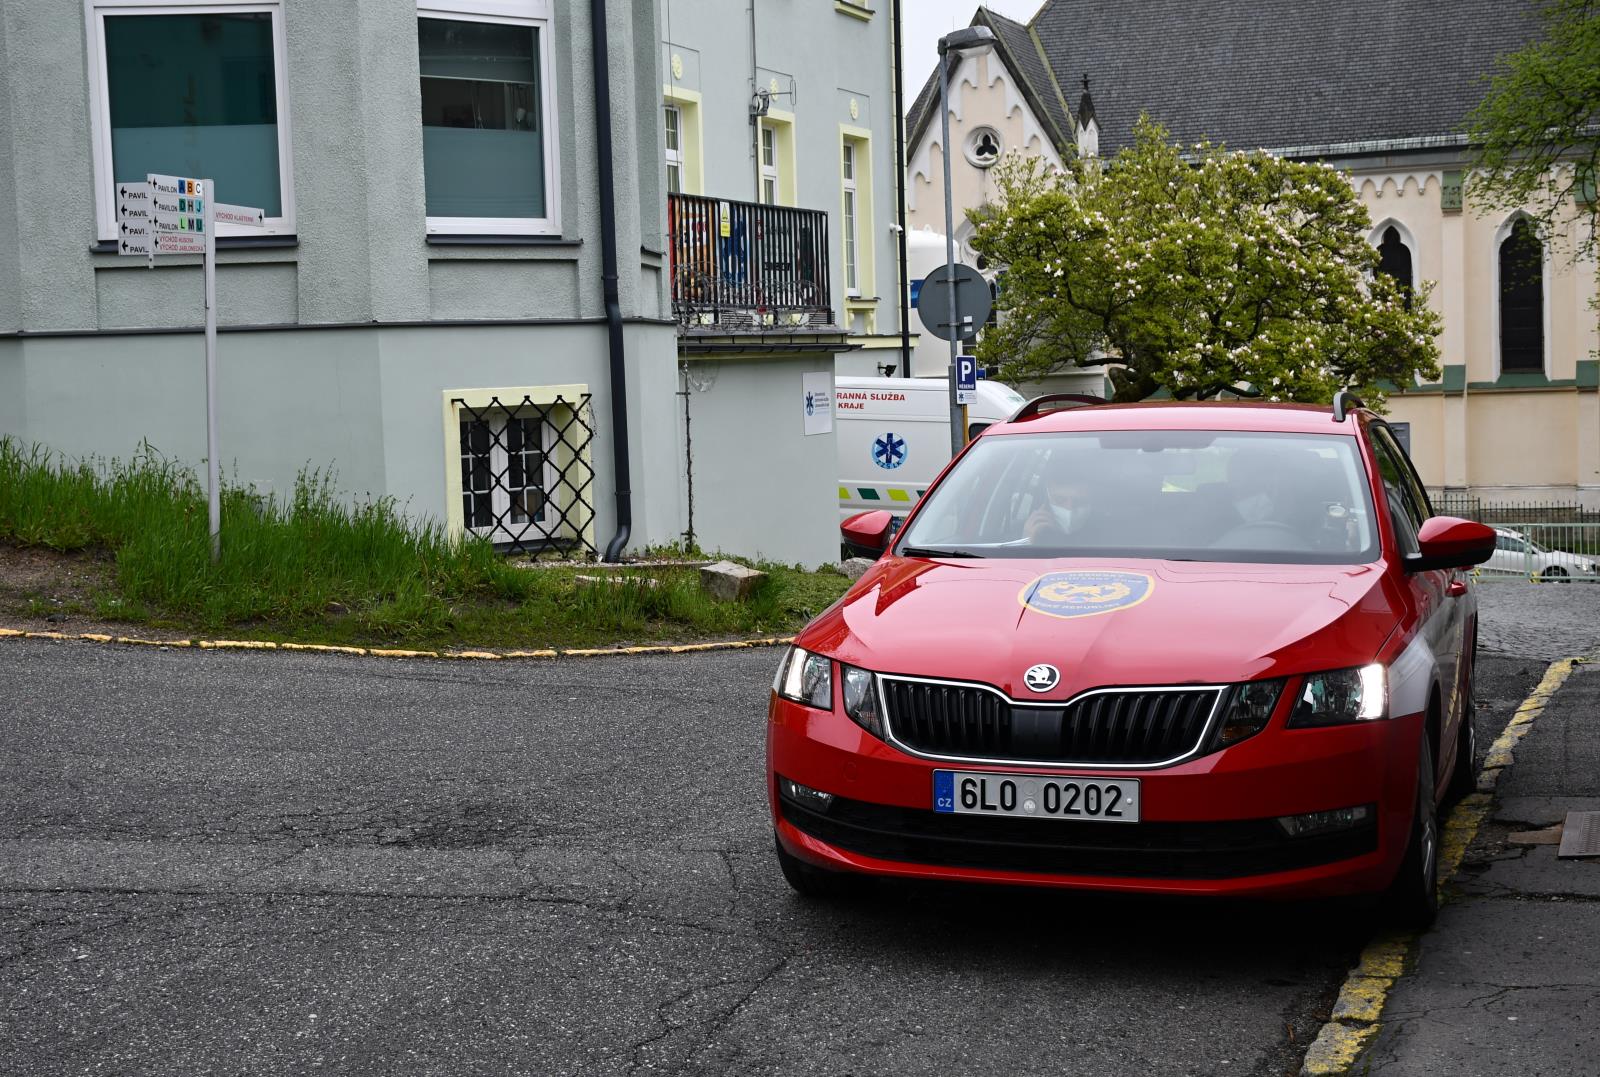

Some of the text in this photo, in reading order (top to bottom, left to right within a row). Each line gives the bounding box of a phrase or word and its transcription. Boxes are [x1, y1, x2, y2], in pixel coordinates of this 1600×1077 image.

[158, 184, 177, 193] PAVILON
[187, 182, 193, 193] B
[195, 183, 201, 194] C
[158, 203, 178, 212] PAVILON
[196, 201, 201, 212] J
[159, 222, 179, 231] PAVILON
[180, 218, 185, 229] L
[188, 219, 195, 230] M
[961, 360, 972, 382] P
[836, 391, 906, 401] RANNÁ SLUŽBA
[838, 402, 865, 410] KRAJE
[937, 797, 952, 808] CZ
[1043, 782, 1123, 817] 0202
